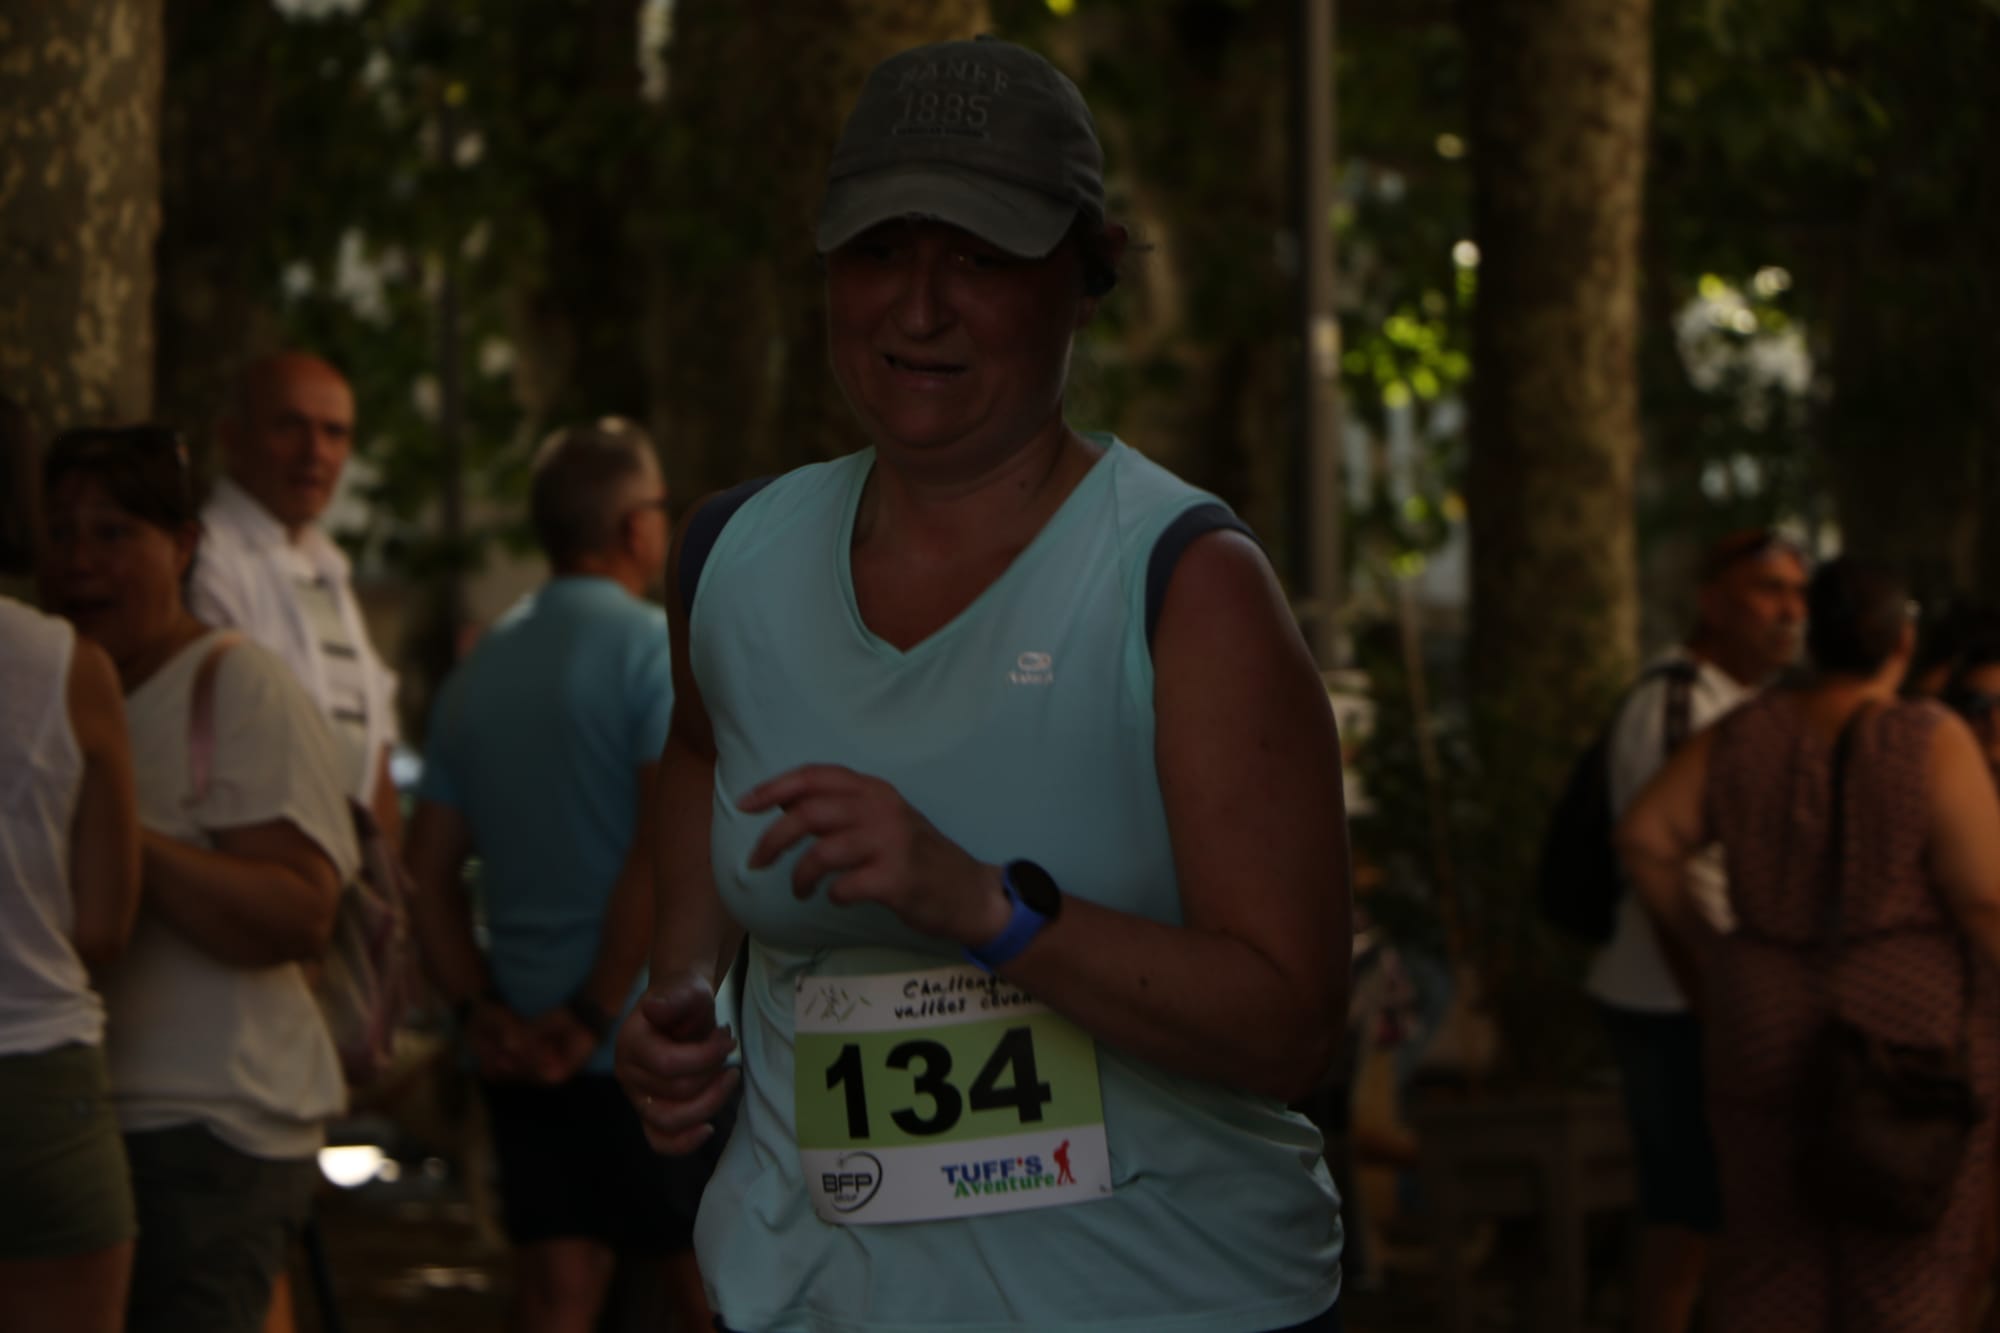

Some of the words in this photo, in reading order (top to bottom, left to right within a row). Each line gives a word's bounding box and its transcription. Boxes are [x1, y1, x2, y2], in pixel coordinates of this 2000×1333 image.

[825, 1026, 1052, 1139] 134
[822, 1173, 872, 1194] BFP
[941, 1155, 1043, 1185] TUFF'S
